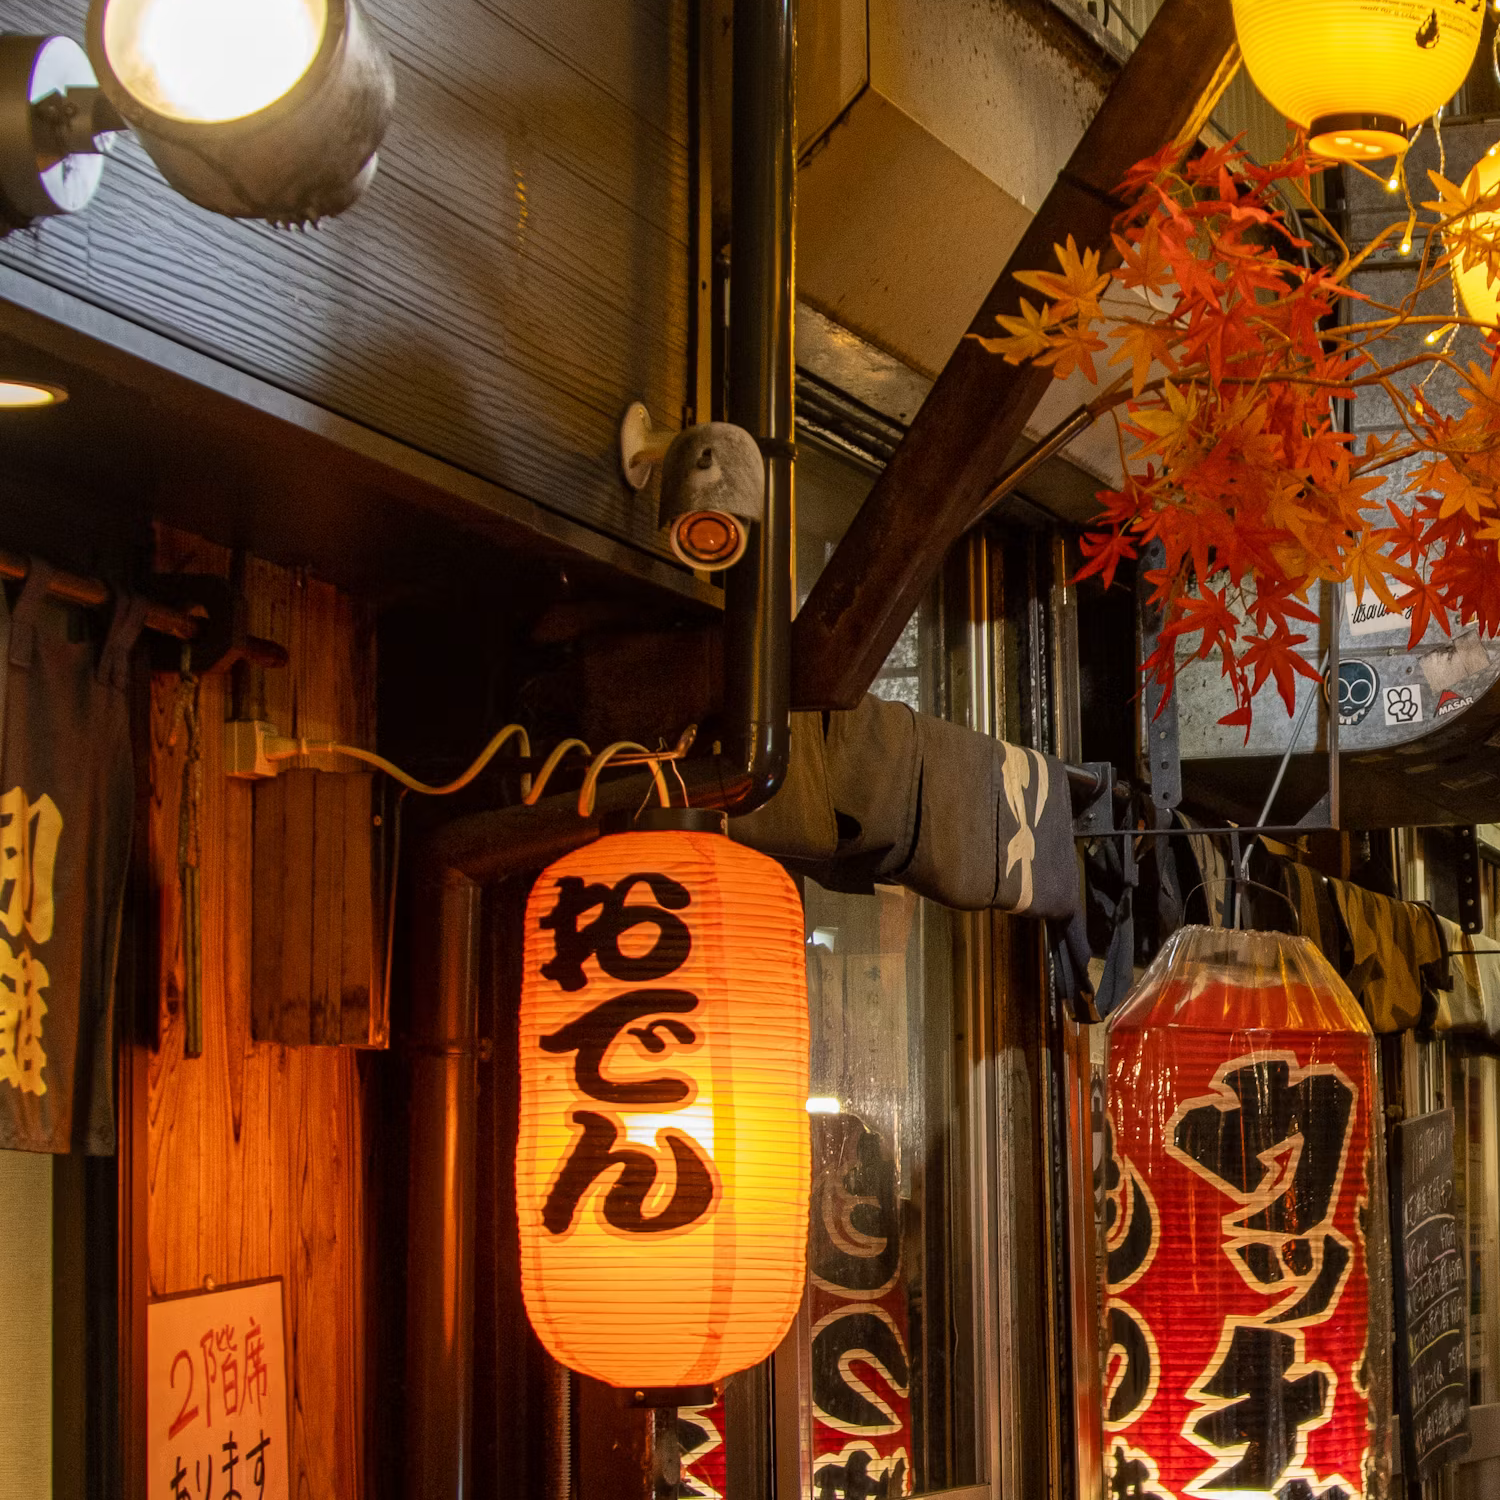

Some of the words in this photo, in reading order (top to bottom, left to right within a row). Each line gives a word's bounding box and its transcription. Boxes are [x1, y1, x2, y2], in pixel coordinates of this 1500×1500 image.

[538, 871, 723, 1237] おでん
[168, 1316, 269, 1441] 2階席
